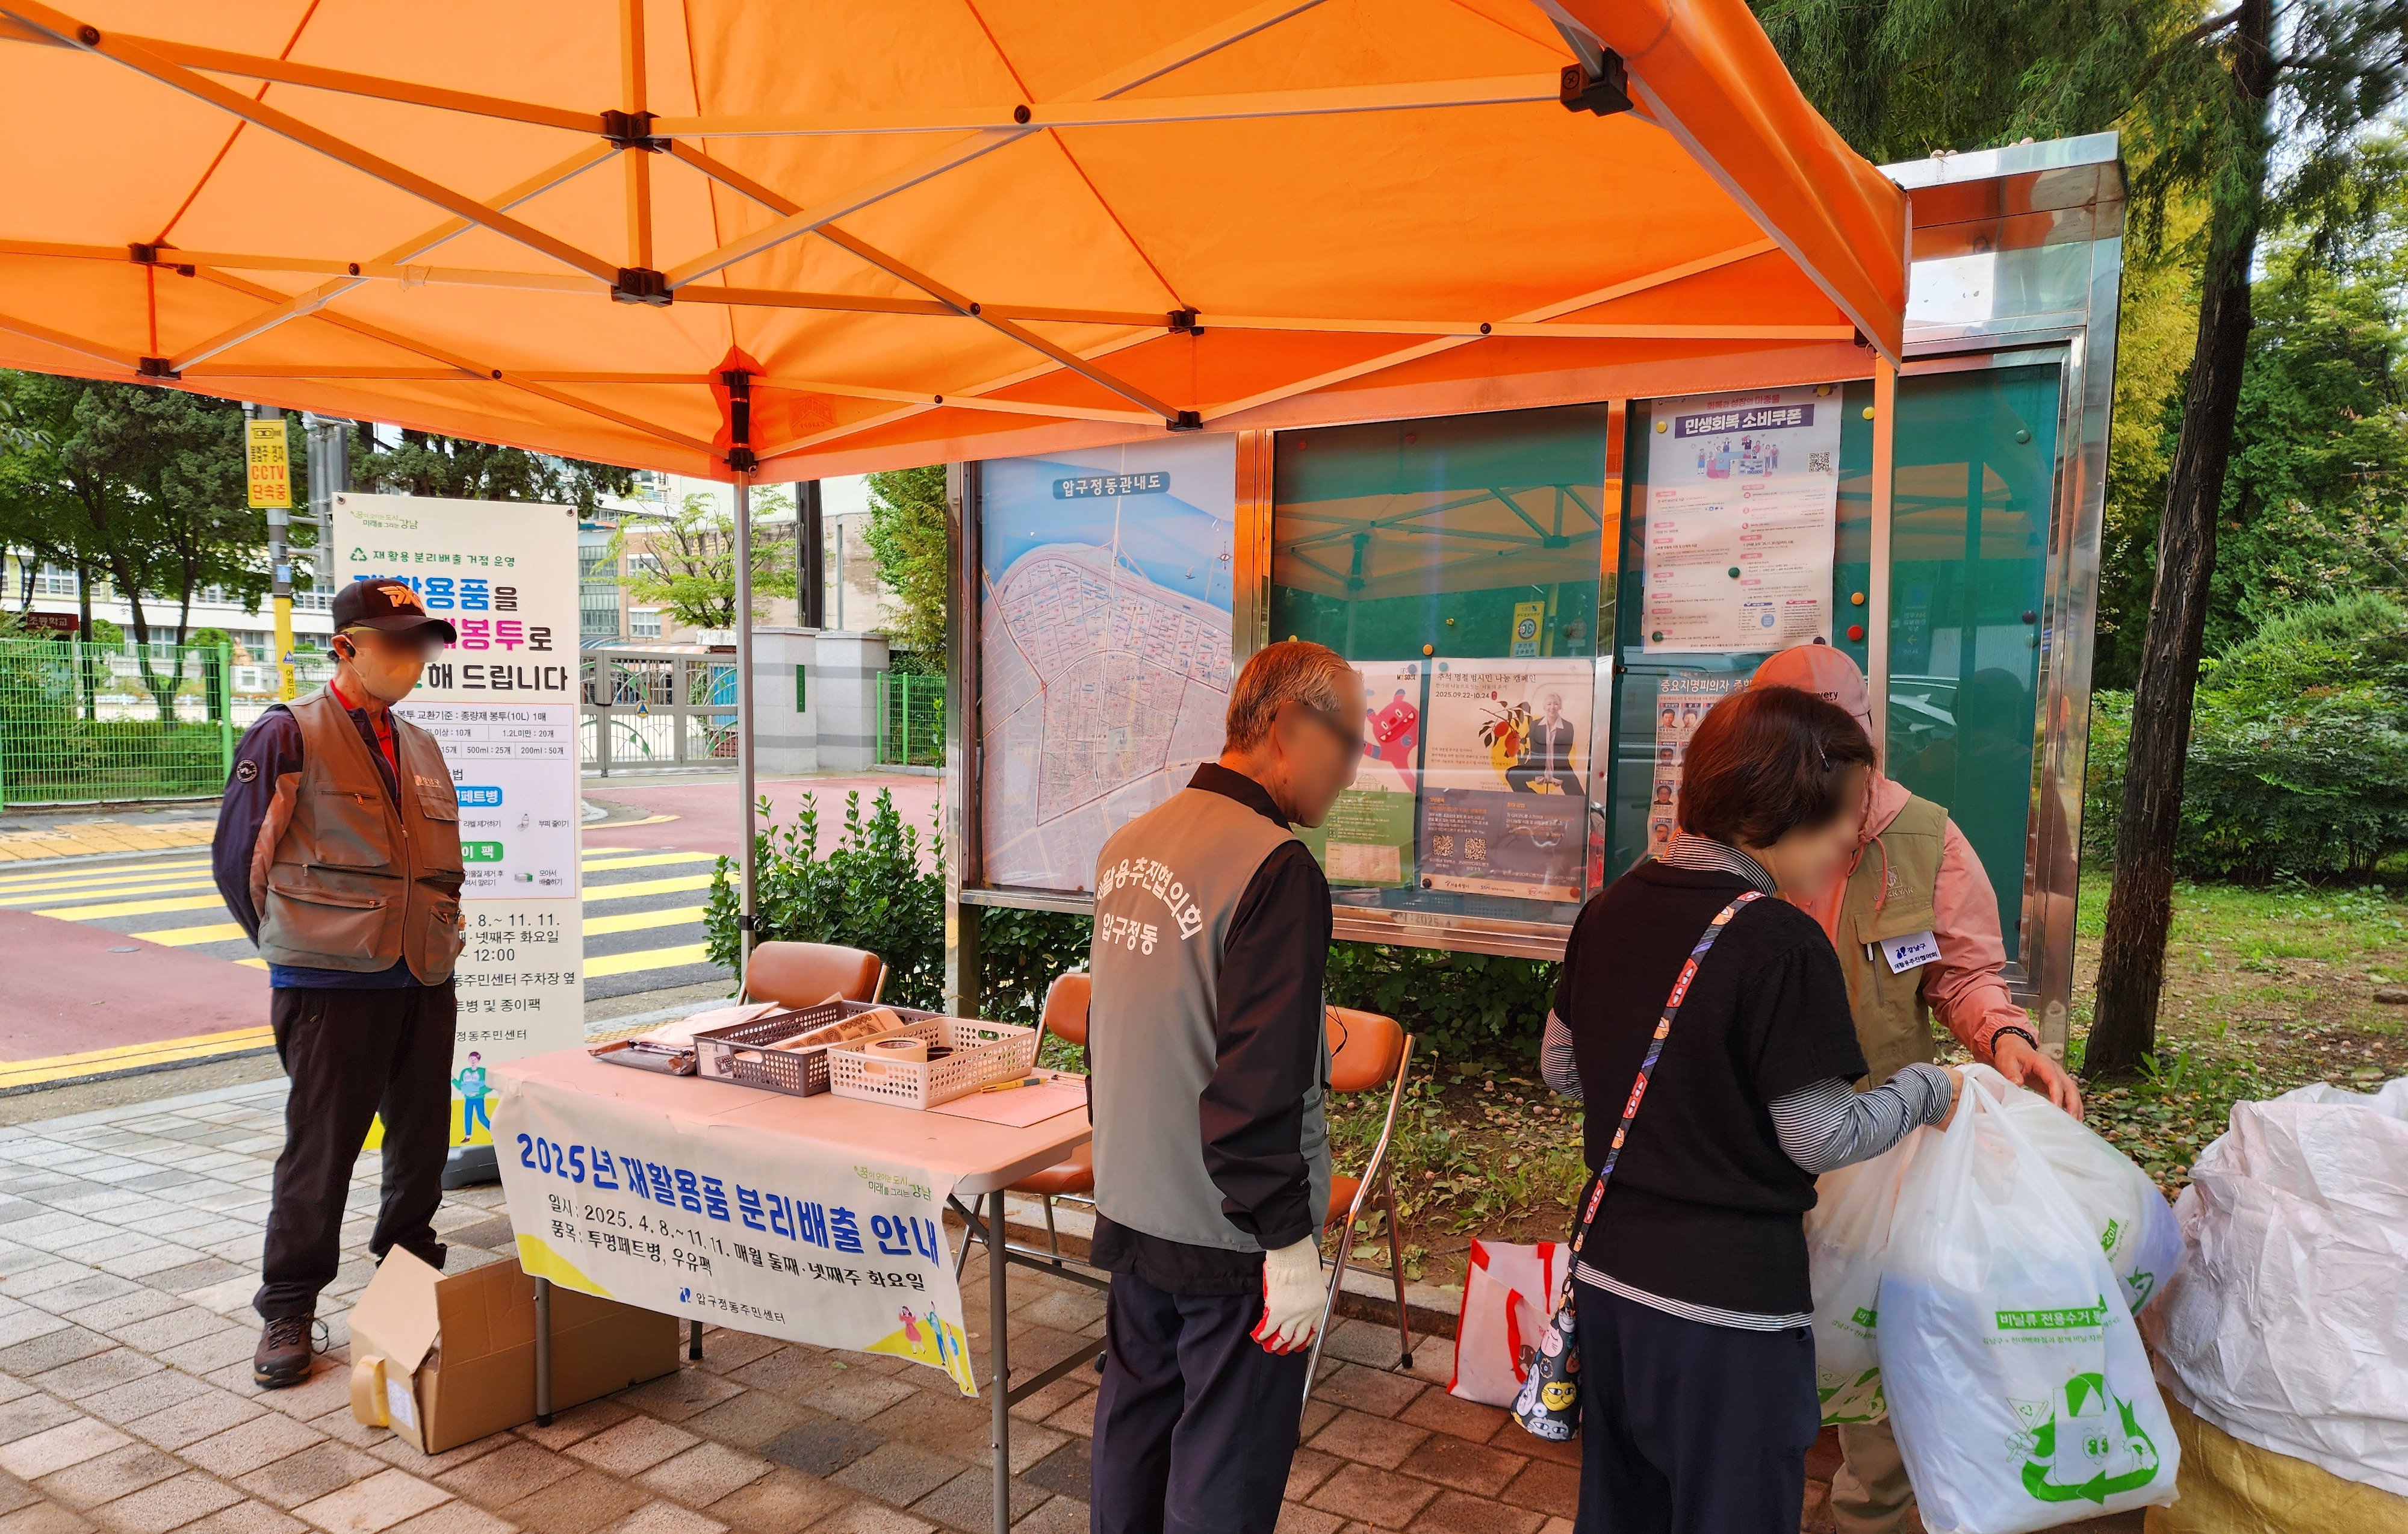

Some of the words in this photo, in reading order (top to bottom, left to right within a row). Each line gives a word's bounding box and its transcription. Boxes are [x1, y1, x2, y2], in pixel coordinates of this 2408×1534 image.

[1686, 412, 1739, 435] 민생회복
[1742, 408, 1802, 429] 소비쿠폰
[252, 465, 285, 480] CCTV
[253, 484, 285, 500] 단속중
[1063, 474, 1161, 497] 압구정동관내도
[400, 518, 418, 529] 강남
[373, 550, 409, 562] 재활용
[415, 553, 462, 566] 분리배출
[469, 555, 489, 567] 거점
[494, 556, 515, 568] 운영
[462, 664, 568, 692] 드립니다
[1438, 673, 1451, 682] 추석
[1454, 673, 1468, 682] 명절
[1471, 674, 1492, 682] 범시민
[1495, 674, 1510, 683] 나눔
[1513, 674, 1536, 683] 캠페인
[1660, 678, 1730, 693] 중요지명피의자
[417, 710, 453, 721] 교환기준
[461, 711, 487, 721] 종량제
[489, 711, 530, 722] 봉투(10L)
[533, 712, 547, 721] 1매
[456, 729, 471, 738] 10개
[503, 729, 532, 738] 1.2L미만
[539, 730, 554, 738] 20개
[495, 747, 510, 755] 25개
[548, 747, 564, 755] 50개
[457, 789, 498, 804] 페트병
[520, 930, 559, 943] 화요일
[1101, 912, 1159, 956] 압구정동
[474, 948, 515, 961] 12:00
[1907, 943, 1926, 954] 강남구
[520, 972, 560, 986] 주차장
[563, 972, 575, 985] 옆
[483, 999, 496, 1013] 및
[500, 998, 541, 1013] 종이팩
[456, 1029, 527, 1042] 정동주민센터
[876, 1173, 892, 1183] 모이는
[893, 1176, 907, 1186] 도시
[891, 1188, 910, 1197] 그리는
[908, 1184, 931, 1202] 강남
[517, 1133, 619, 1190] 2025년
[619, 1157, 731, 1223] 재활용품
[735, 1184, 865, 1255] 분리배출
[870, 1214, 940, 1270] 안내
[584, 1205, 633, 1229] 2025.
[639, 1215, 655, 1234] 4.
[733, 1242, 765, 1268] 매월
[866, 1270, 926, 1293] 화요일
[587, 1229, 667, 1267] 투명페트병,
[671, 1247, 713, 1278] 우유팩
[696, 1293, 786, 1324] 압구정동주민센터
[1999, 1313, 2038, 1328] 비닐류
[2041, 1310, 2091, 1327] 전용수거
